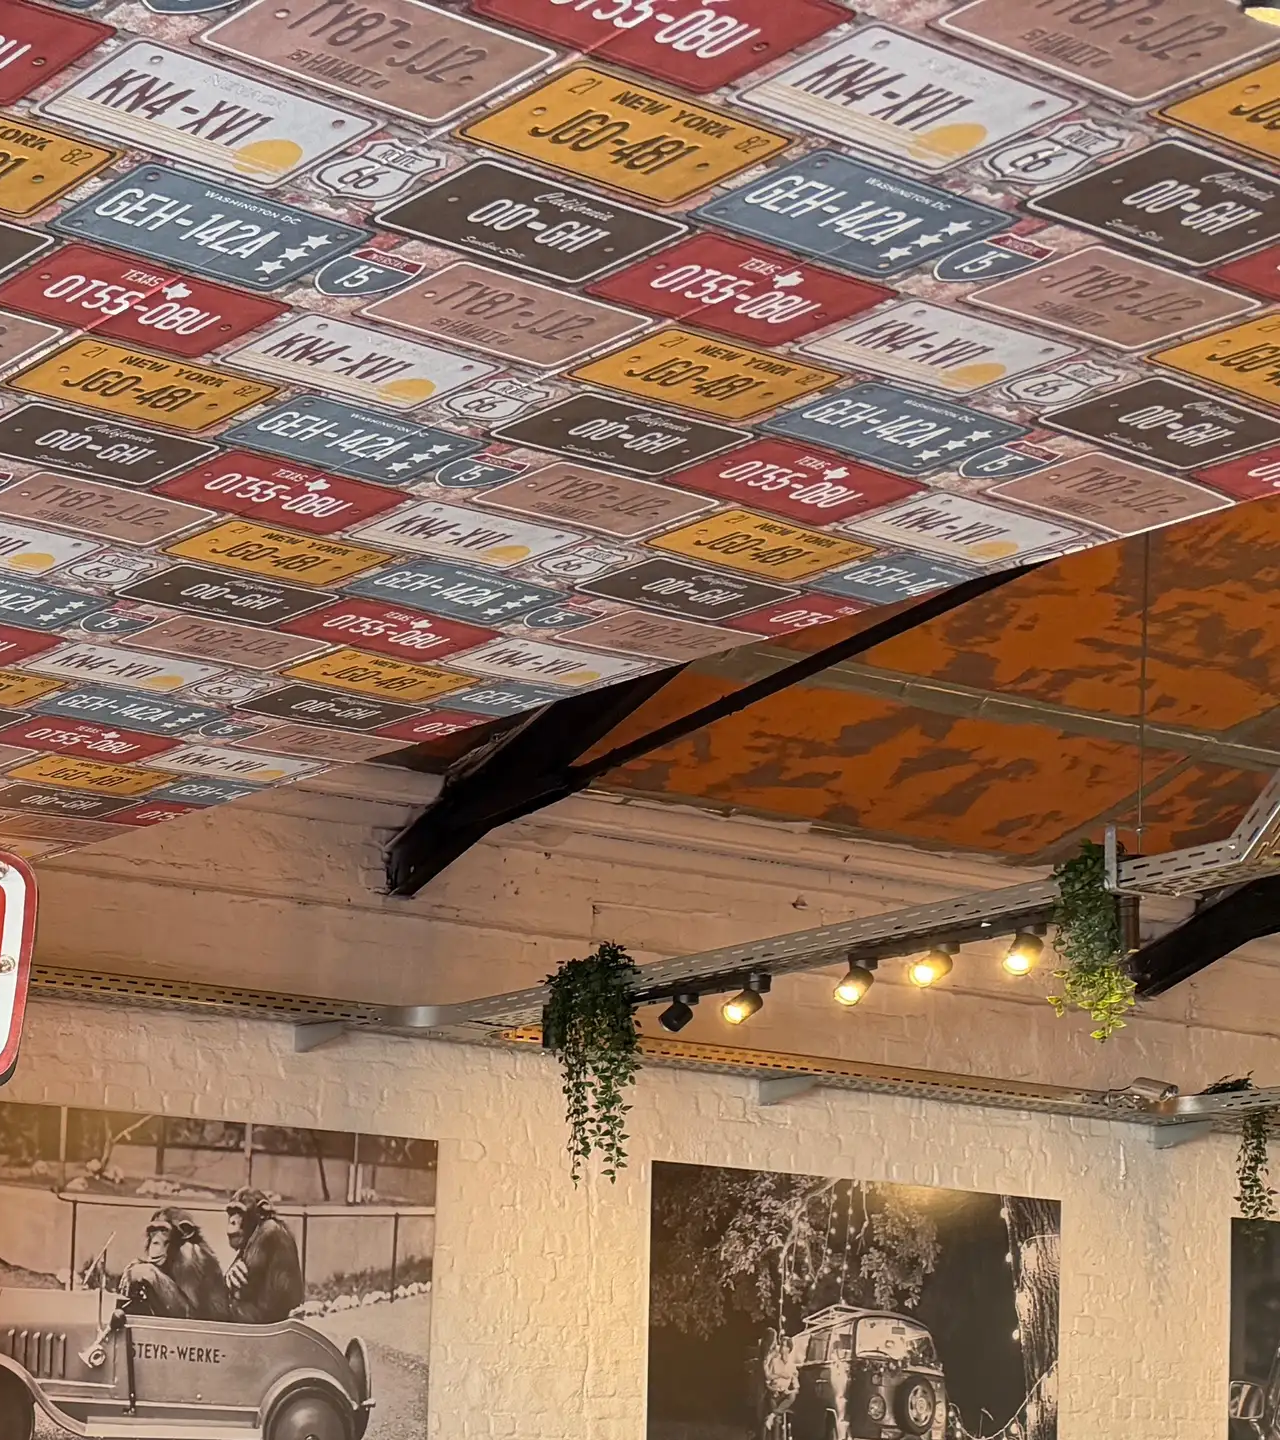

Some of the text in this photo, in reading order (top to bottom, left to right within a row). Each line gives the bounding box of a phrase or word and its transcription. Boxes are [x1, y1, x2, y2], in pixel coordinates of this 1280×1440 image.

[84, 70, 271, 146] KN4-XV1
[602, 91, 734, 140] NEW YORK
[789, 53, 972, 131] KN4-XV1
[517, 110, 705, 174] JGO-481
[332, 165, 394, 189] 66
[748, 172, 928, 247] GEH-142A
[96, 186, 283, 258] GEH-142A
[257, 410, 413, 461] GEH-142A
